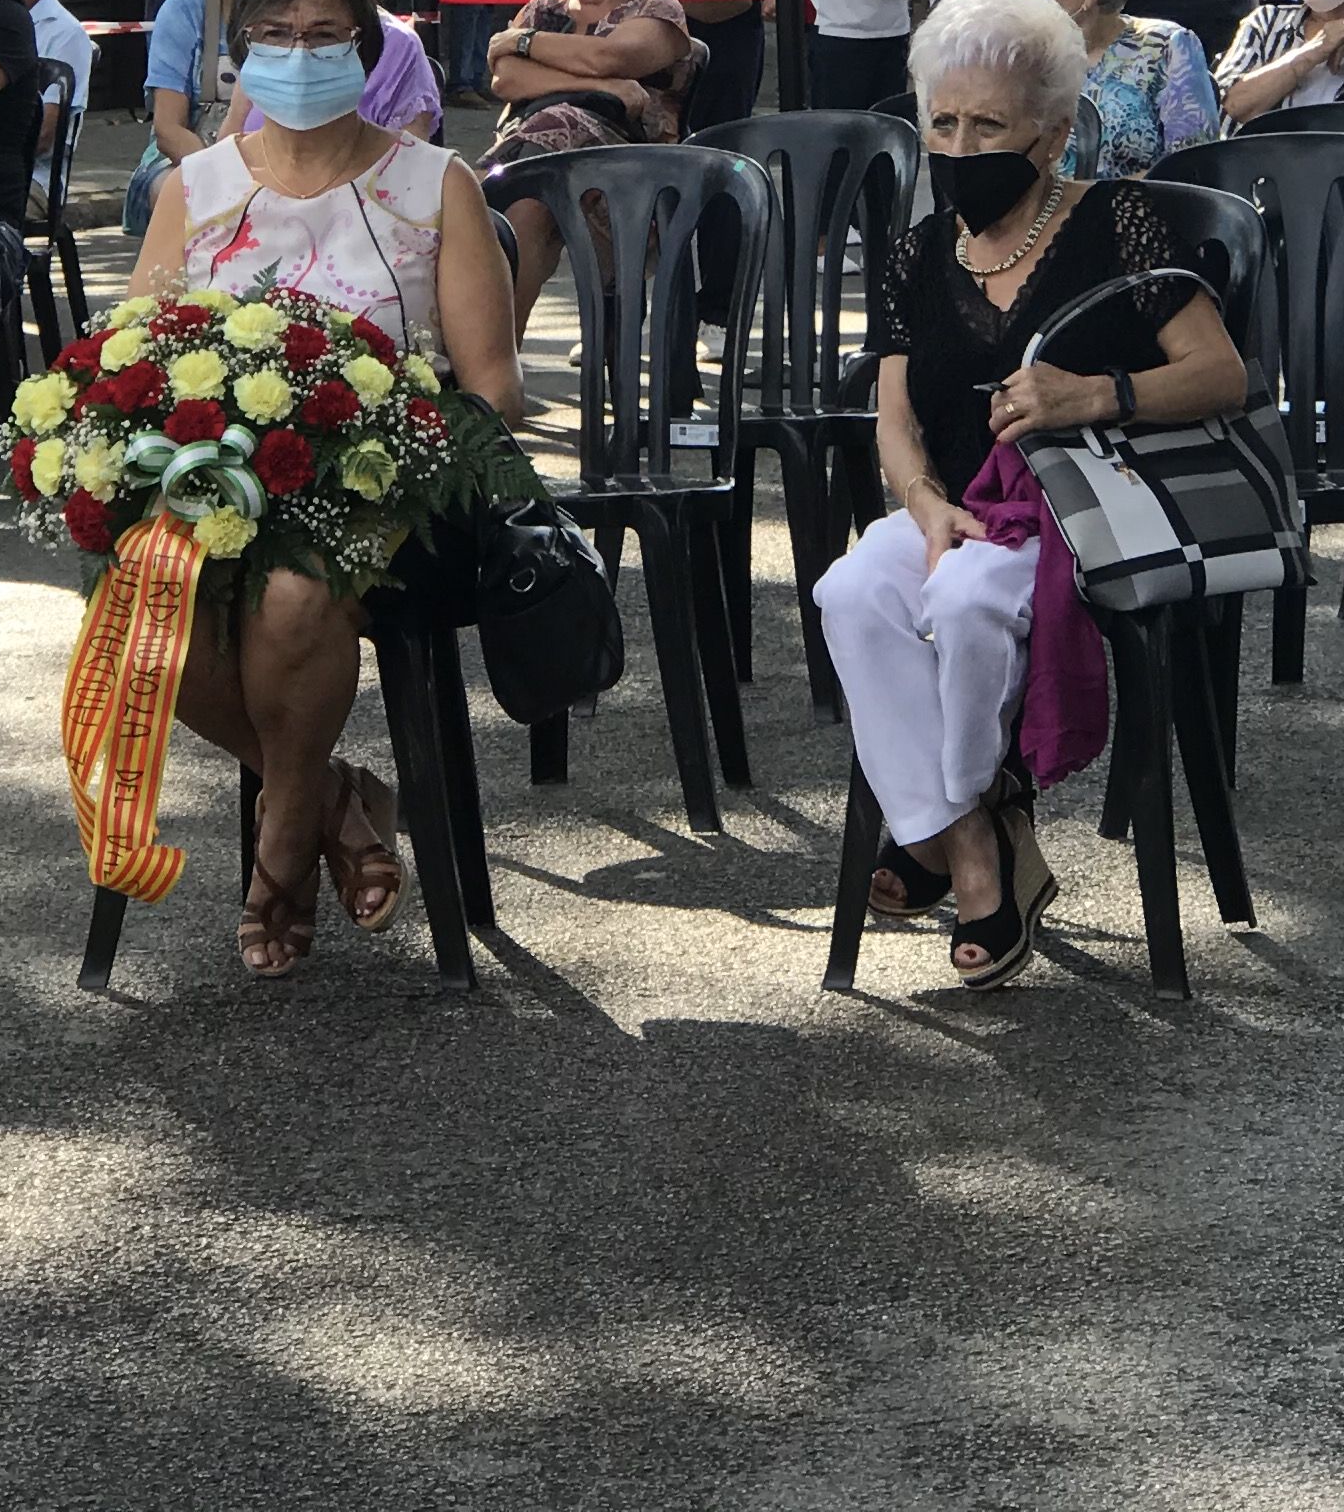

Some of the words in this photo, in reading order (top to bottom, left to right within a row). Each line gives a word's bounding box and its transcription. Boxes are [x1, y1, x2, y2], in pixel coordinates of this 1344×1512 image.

[68, 559, 142, 726] ANDALUCIA
[120, 529, 195, 738] CERDANYOLA
[113, 769, 144, 808] DEL
